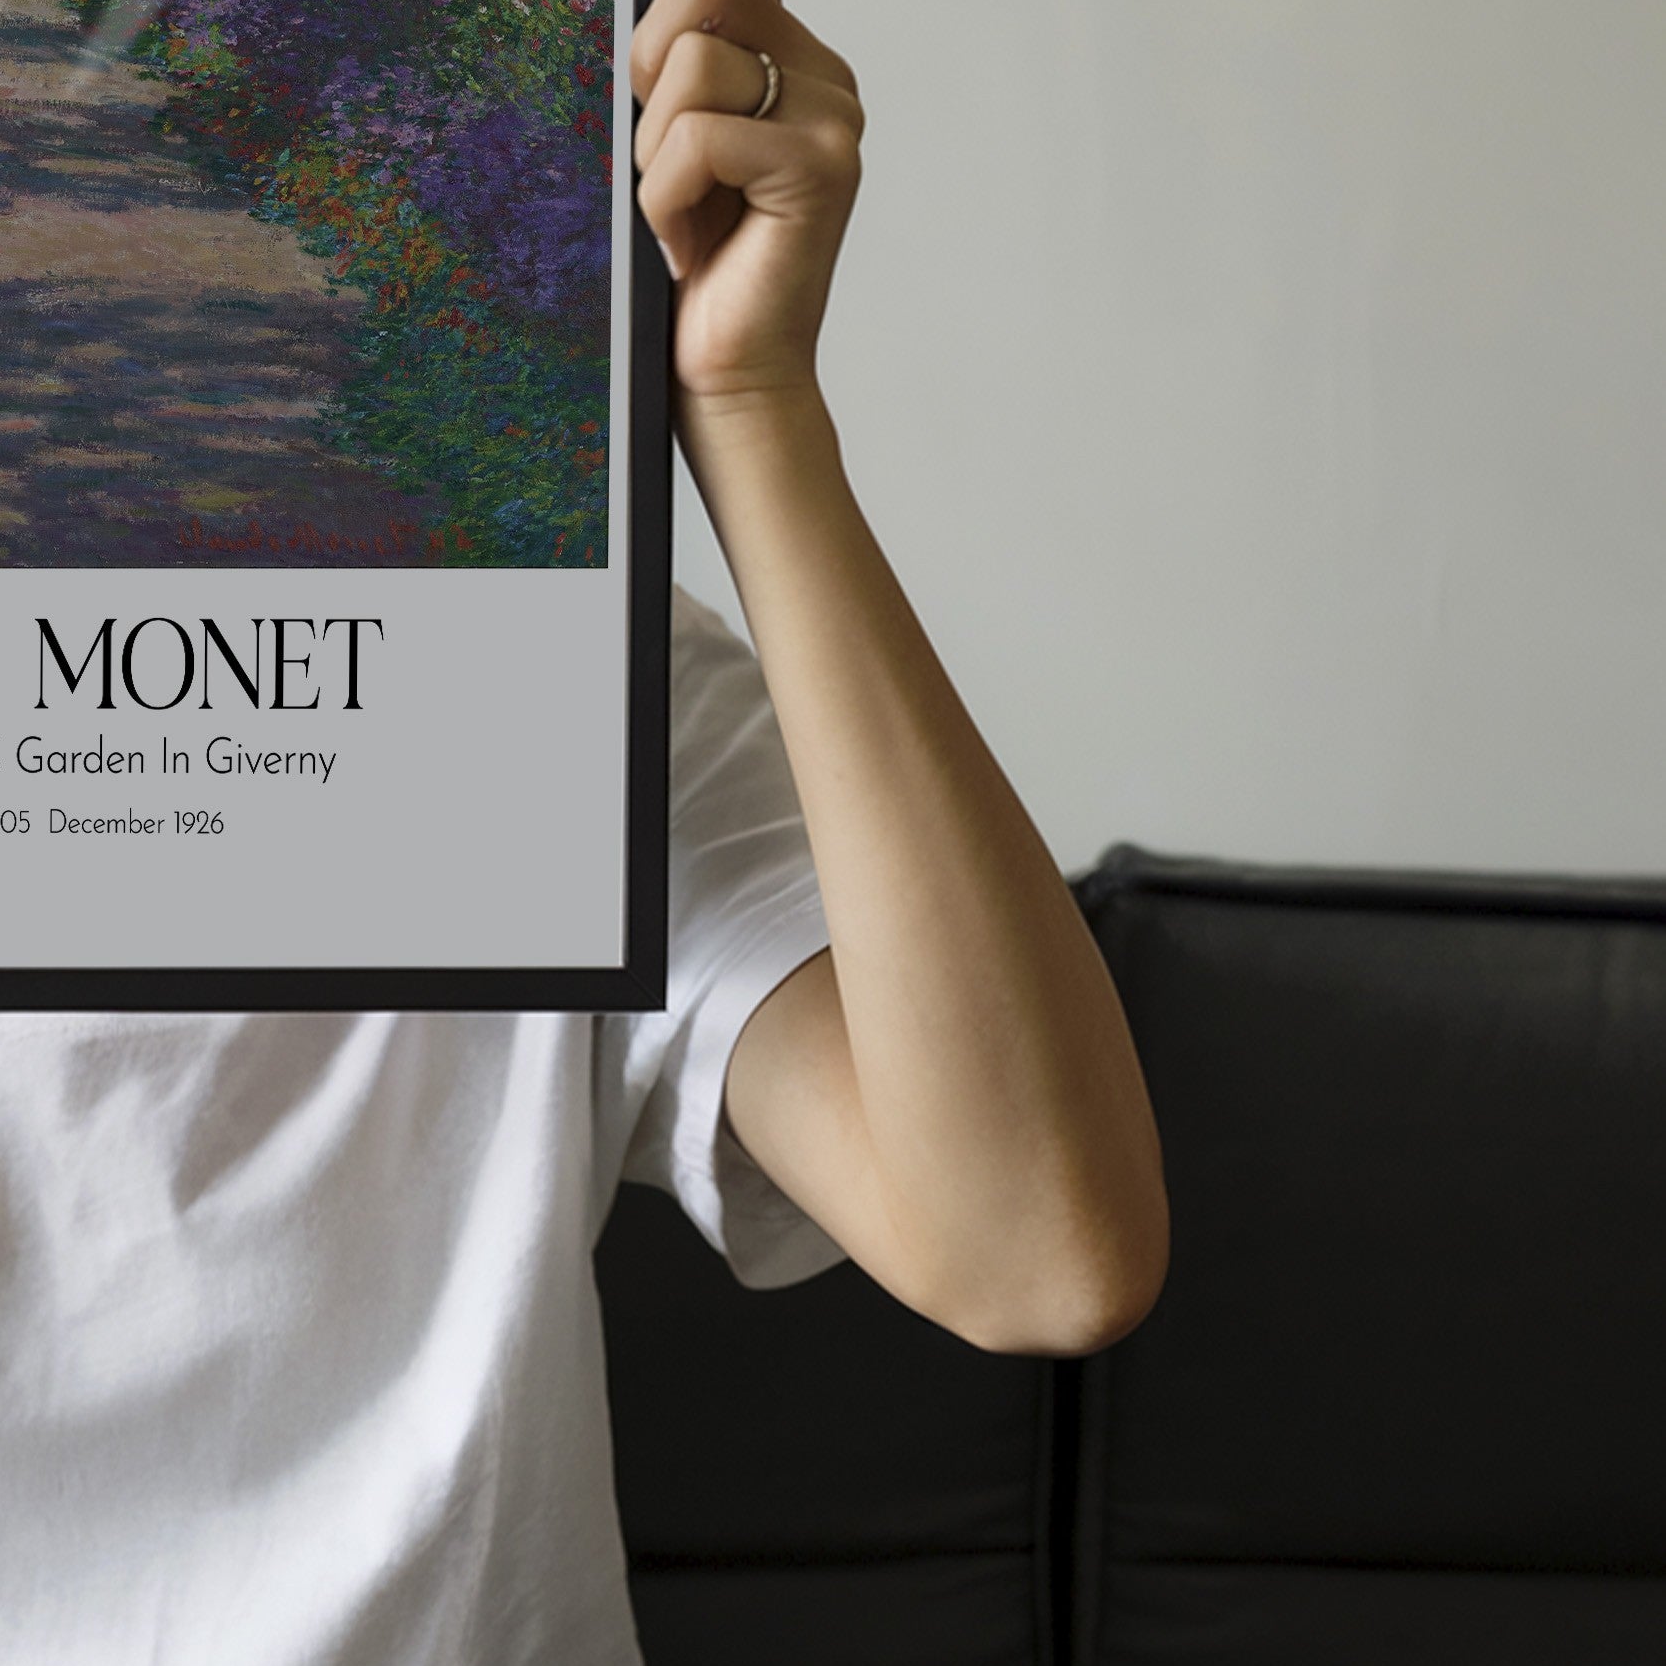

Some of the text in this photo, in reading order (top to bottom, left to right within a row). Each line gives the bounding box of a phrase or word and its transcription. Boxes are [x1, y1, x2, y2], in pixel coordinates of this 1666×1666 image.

[33, 616, 385, 711] MONET
[15, 733, 144, 775] Garden
[162, 735, 190, 775] In
[204, 735, 337, 784] Giverny
[48, 807, 166, 836] December
[172, 809, 226, 836] 1926
